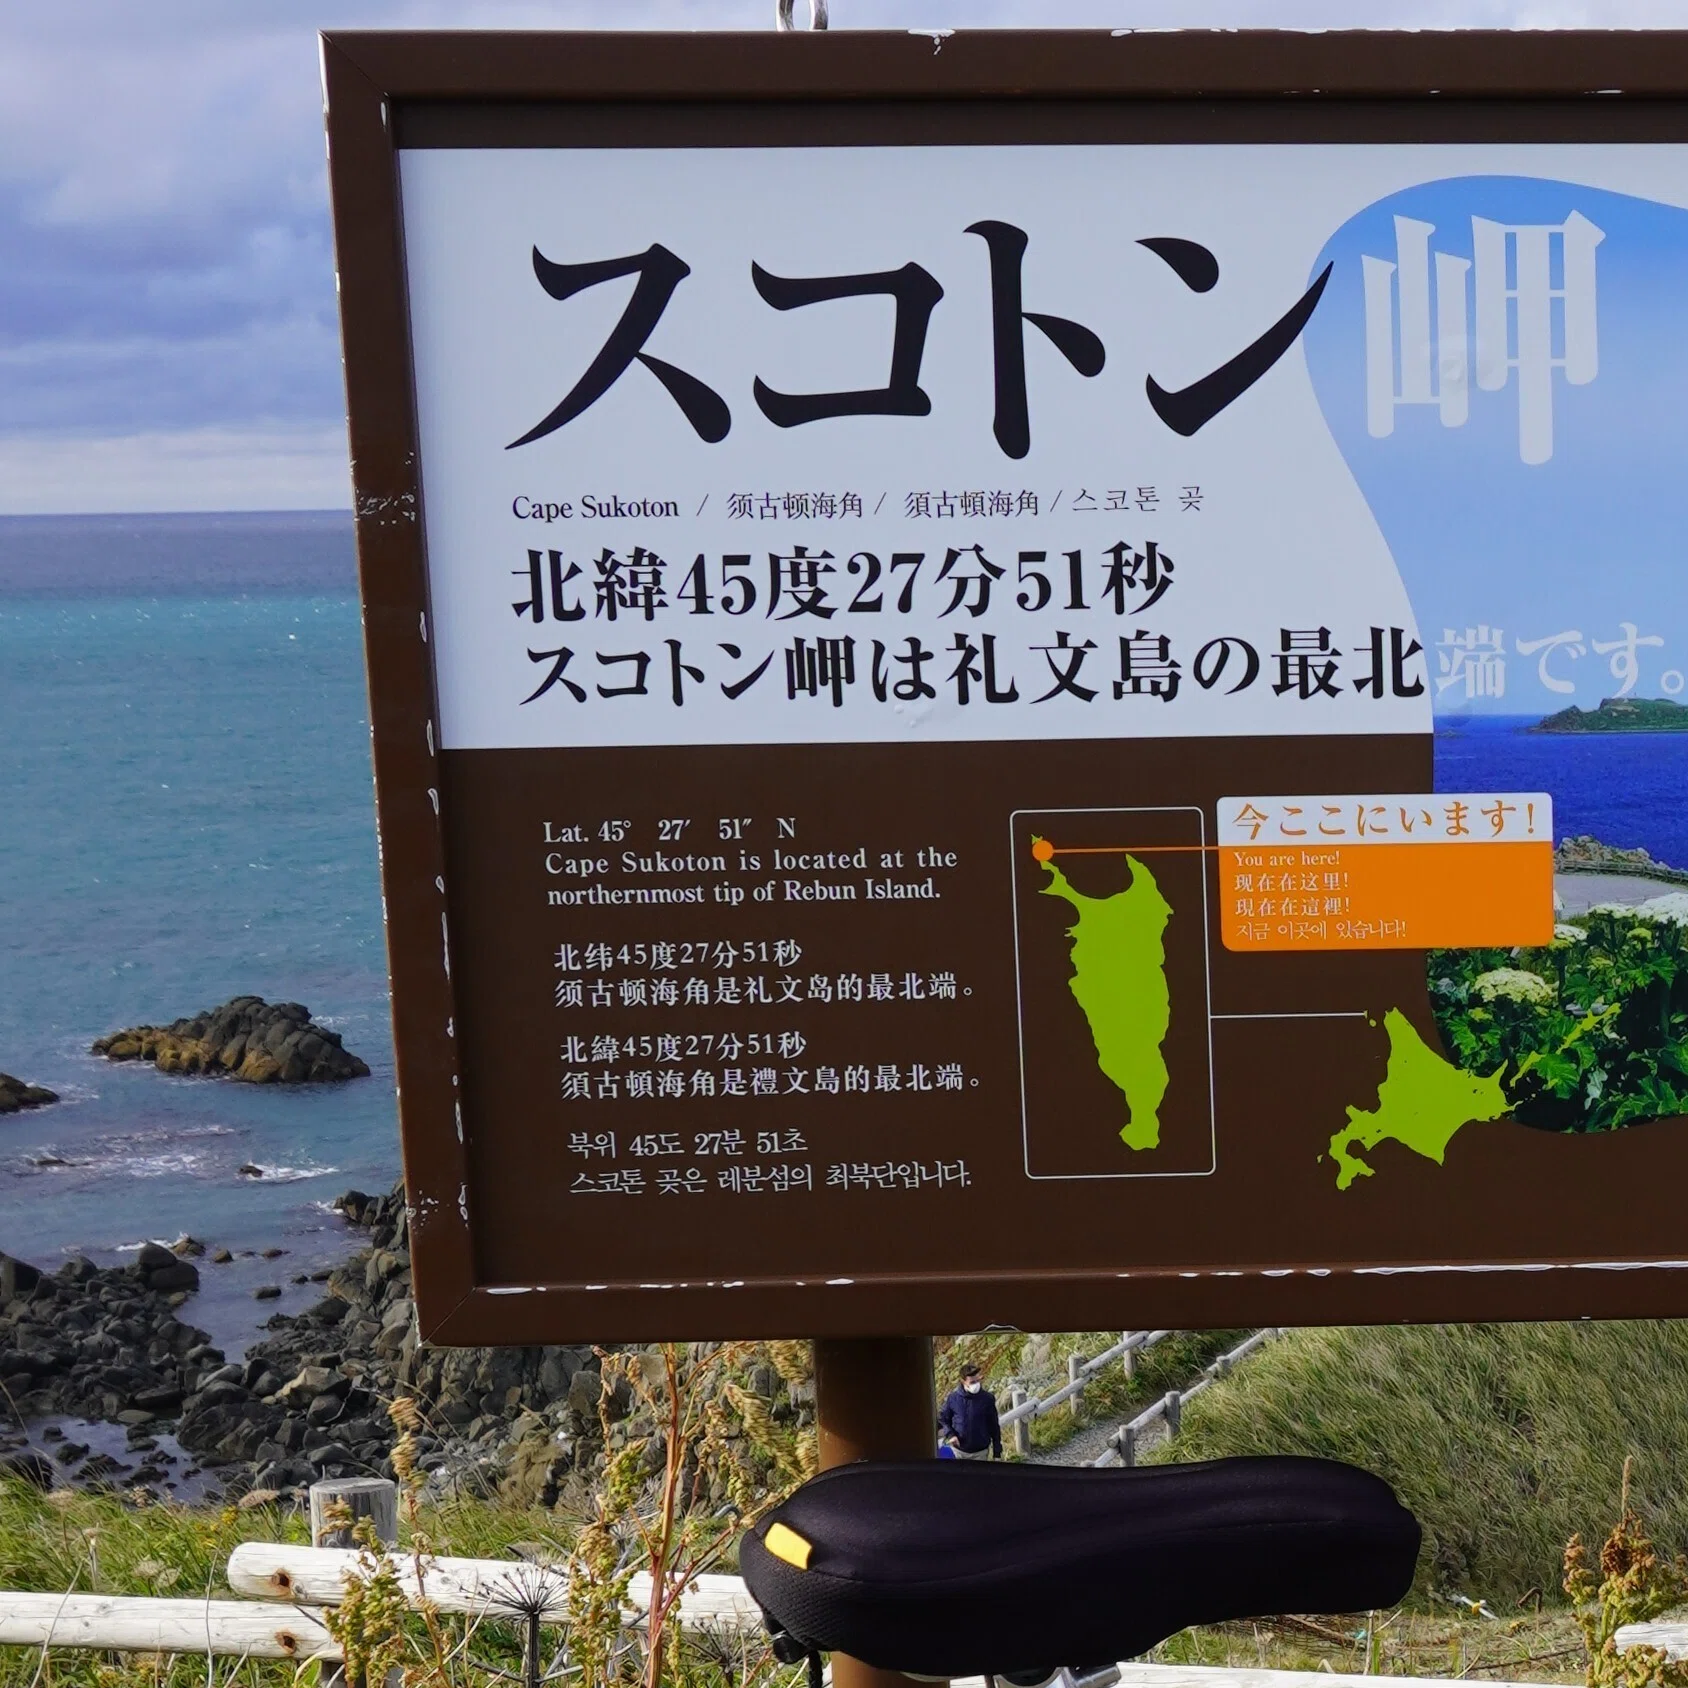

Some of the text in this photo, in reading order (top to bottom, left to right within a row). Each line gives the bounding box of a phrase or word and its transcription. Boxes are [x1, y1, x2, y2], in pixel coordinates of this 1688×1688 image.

[505, 209, 1606, 465] スコトン岬
[512, 495, 573, 523] Cape
[581, 495, 680, 518] Sukoton
[727, 492, 864, 520] 须古顿海角
[904, 489, 1039, 519] 須古頓海角
[1072, 486, 1160, 512] 스코톤
[1177, 485, 1204, 512] 곶
[511, 540, 1175, 622] 北緯45度27分51秒
[519, 622, 1685, 707] スコトン岬は礼文島の最北端です。
[543, 820, 589, 843] Lat.
[597, 818, 632, 842] 45°
[777, 817, 797, 839] N
[545, 846, 958, 877] Cape Sukoton is located at the
[1233, 850, 1341, 867] You are here!
[548, 877, 941, 907] northernmost tip of Rebun Island.
[1236, 919, 1407, 941] 지금 이곳에 있습니다!
[554, 938, 803, 972] 北纬45度27分51秒
[554, 970, 974, 1008] 须古顿海角是礼文岛的最北端。
[560, 1031, 807, 1064] 北緯45度27分51秒
[560, 1063, 980, 1100] 須古頓海角是禮文島的最北端。
[567, 1128, 809, 1160] 북위 45도 27분 51초
[569, 1160, 972, 1195] 스코톤 곶은 레분섬의 최북단입니다.
